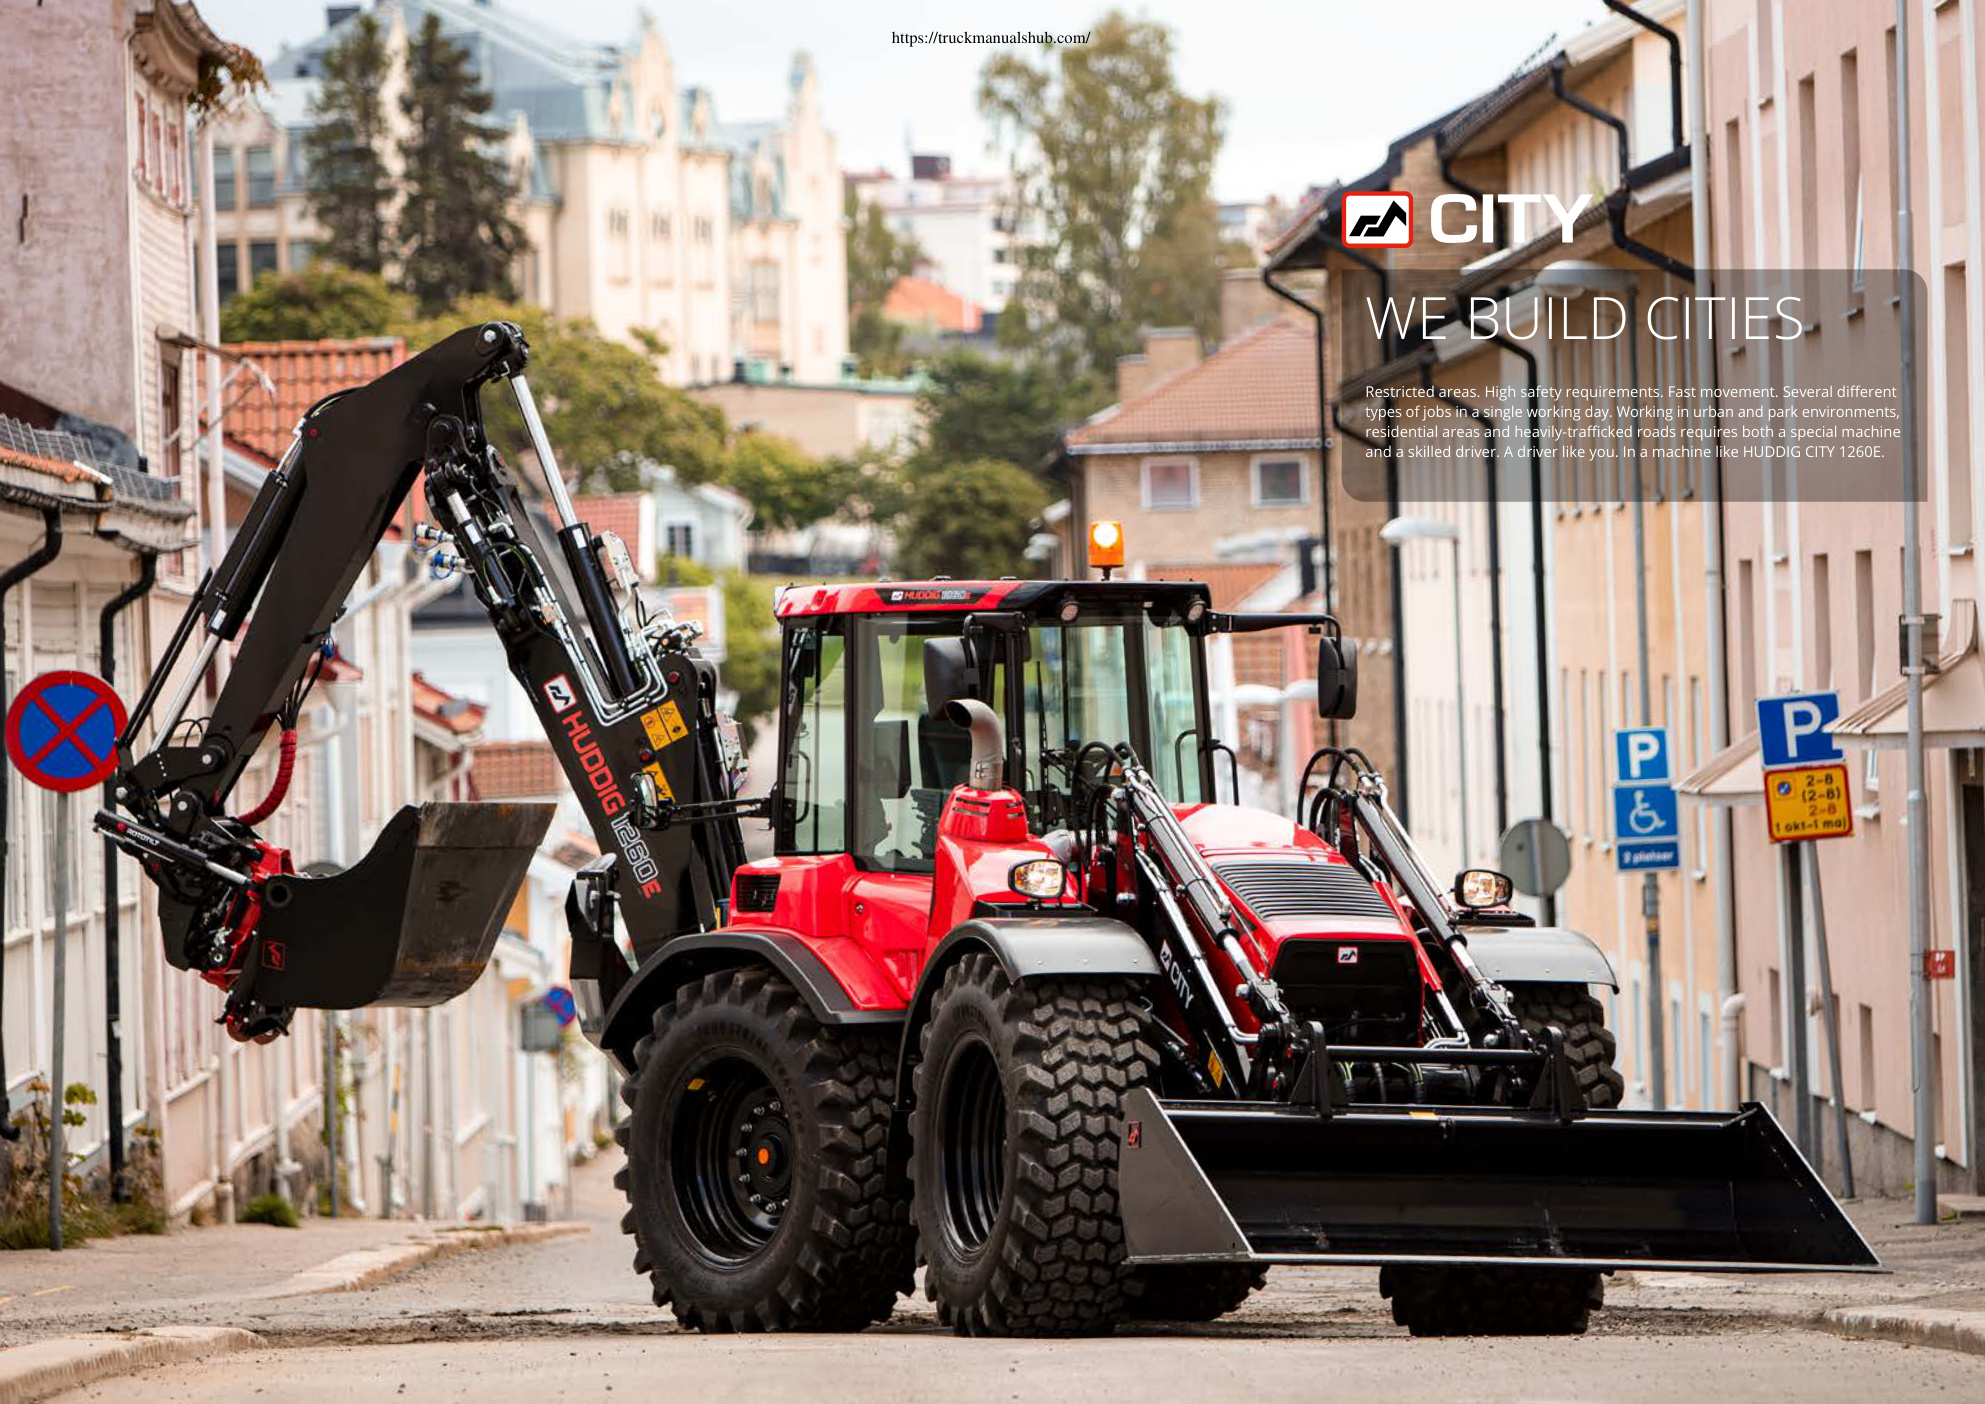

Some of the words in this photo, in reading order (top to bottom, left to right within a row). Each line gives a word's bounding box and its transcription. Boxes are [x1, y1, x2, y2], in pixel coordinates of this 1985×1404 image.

[905, 589, 940, 600] HUDDIG
[1783, 700, 1822, 758] P
[1628, 732, 1660, 778] P
[562, 710, 626, 816] HUDDIG
[611, 811, 662, 899] 1260E
[1170, 960, 1195, 1010] CITY
